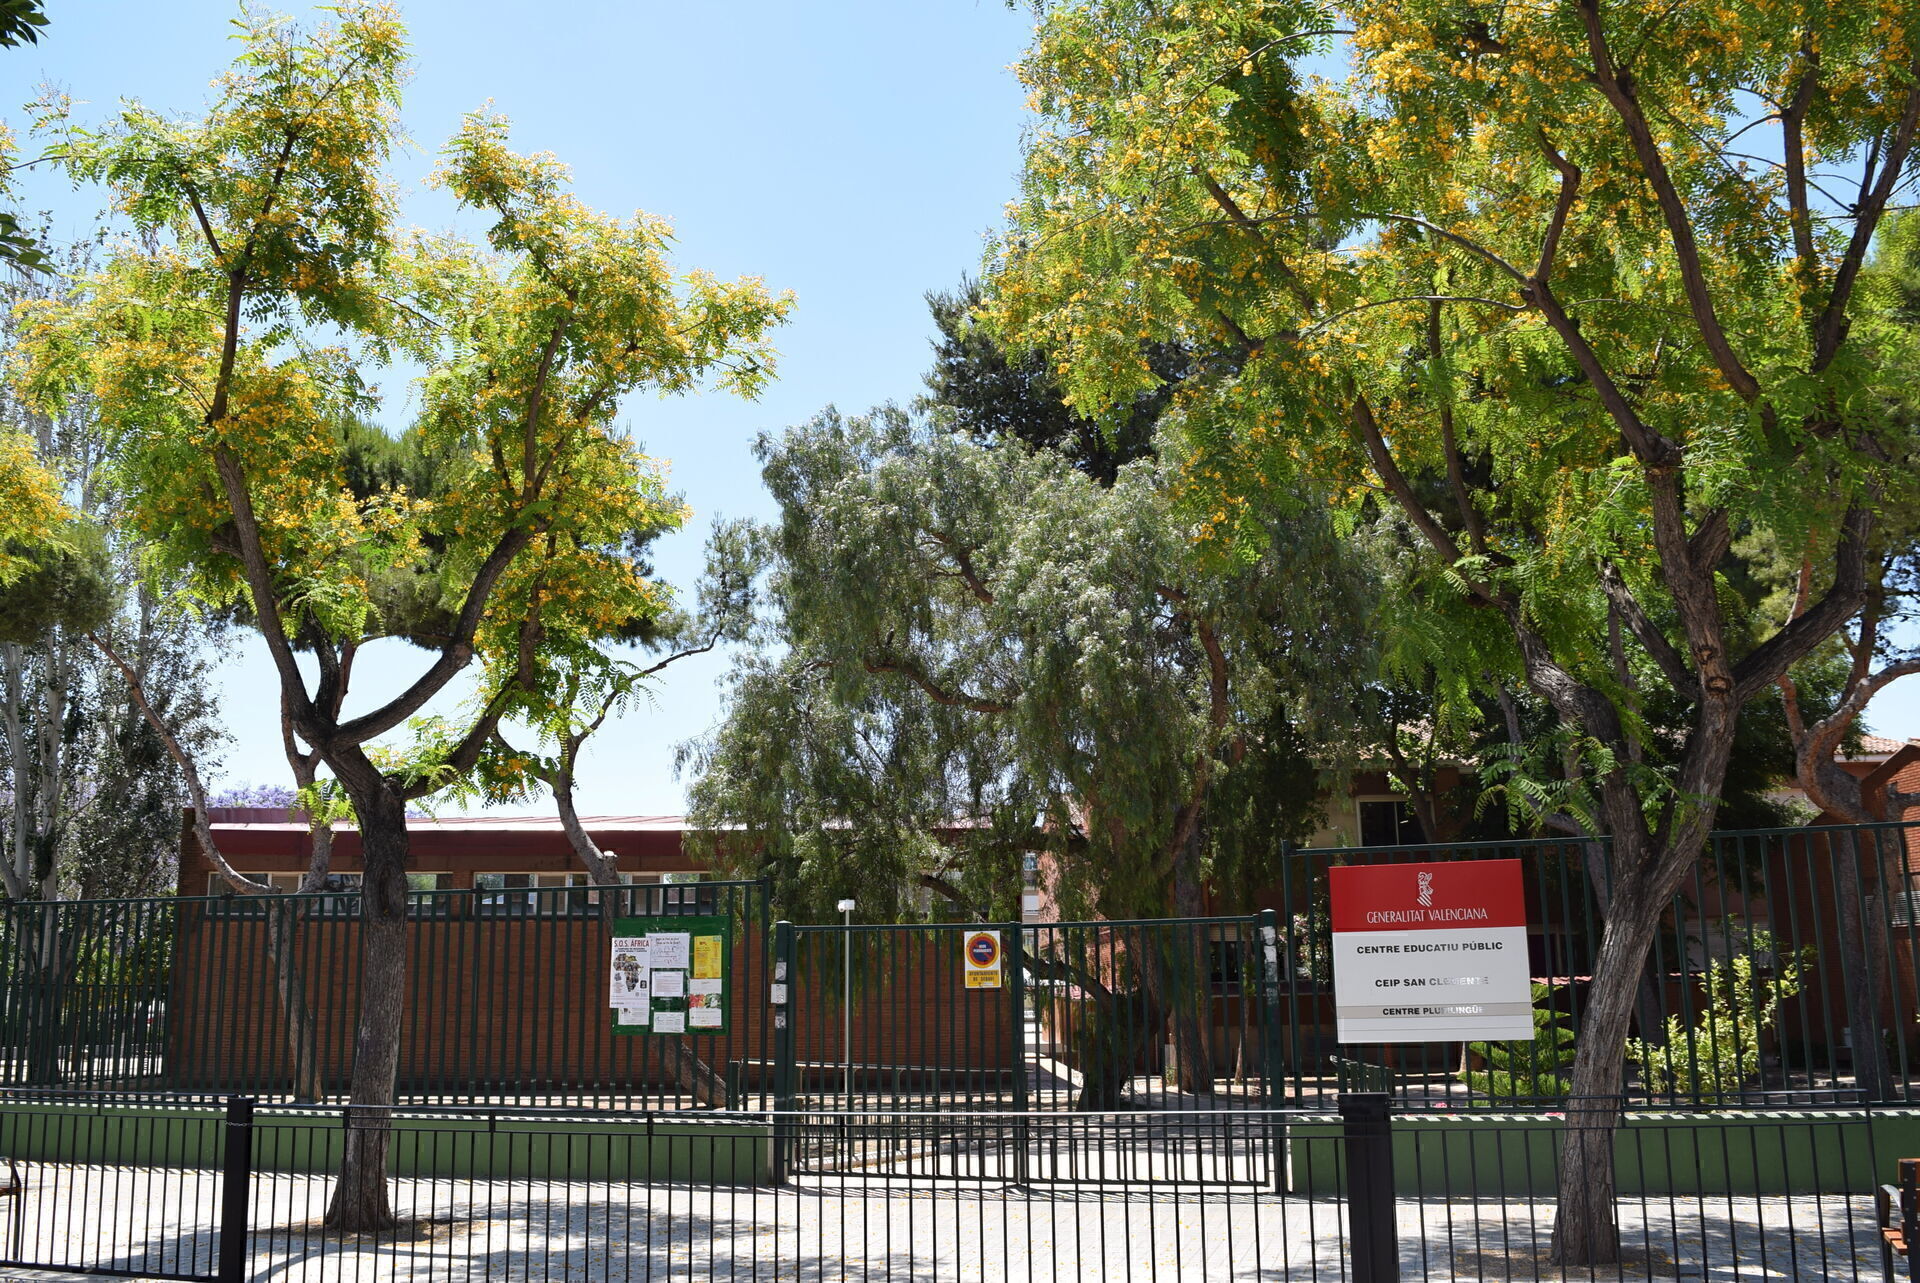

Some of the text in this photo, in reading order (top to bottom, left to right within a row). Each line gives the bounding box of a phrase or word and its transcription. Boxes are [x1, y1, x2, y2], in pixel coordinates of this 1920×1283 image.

[1366, 907, 1488, 924] GENERALITAT VALENCIANA
[614, 939, 629, 947] S.O.S.
[1356, 940, 1503, 954] CENTRE EDUCATIU PÚBLIC
[1375, 979, 1401, 987] CEIP
[1403, 978, 1426, 987] SAN
[1382, 1007, 1420, 1016] CENTRE
